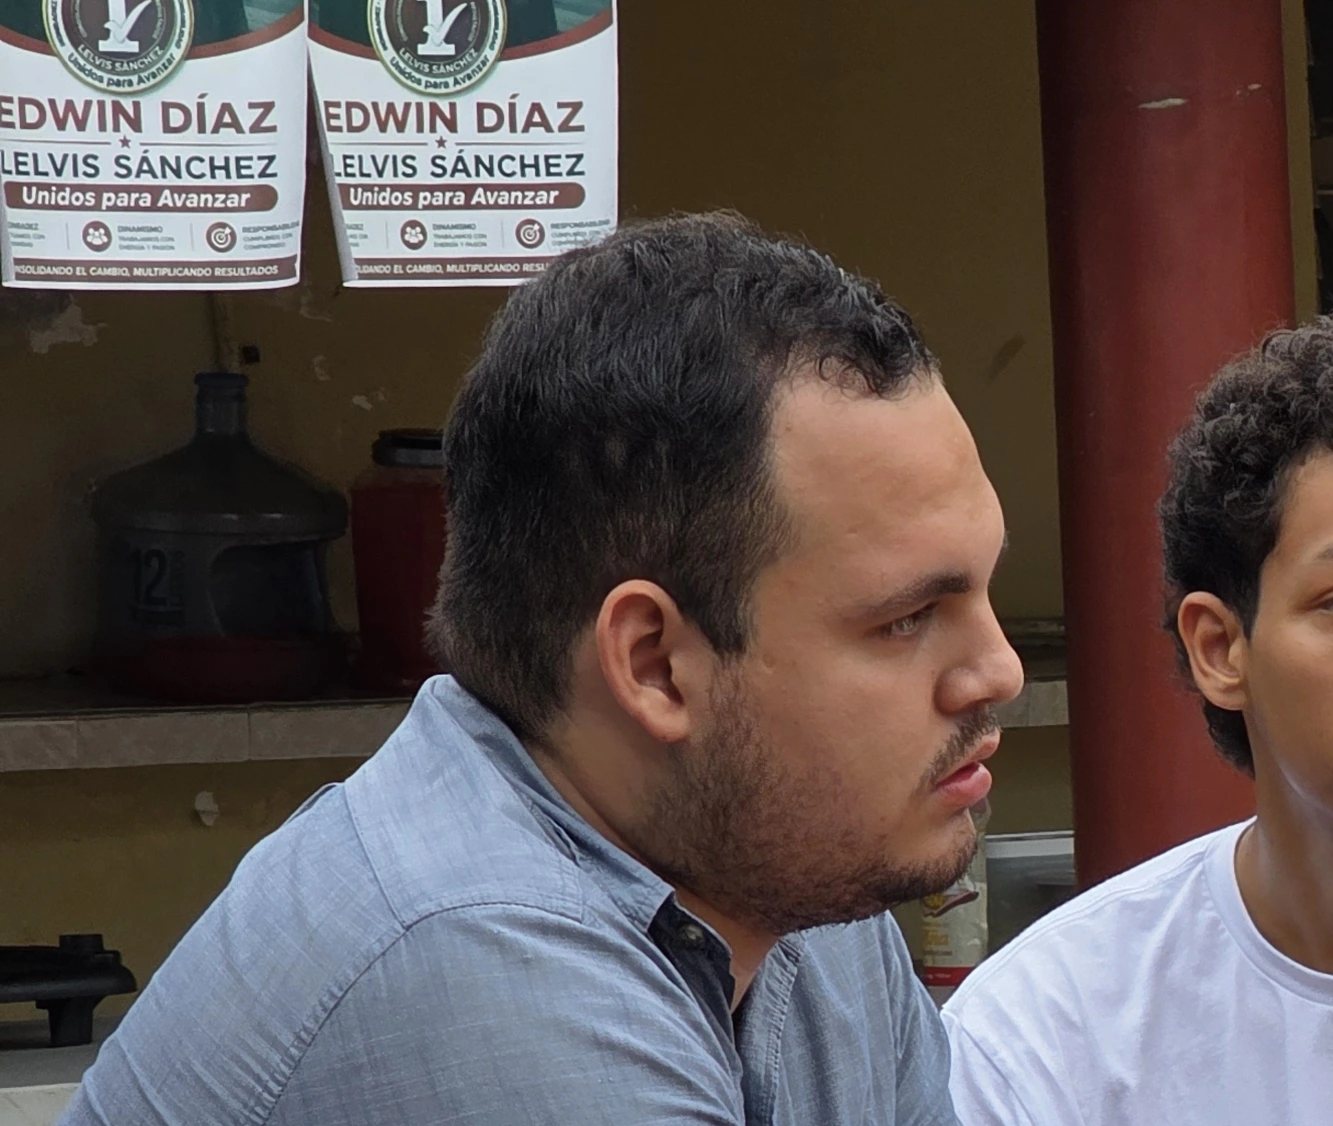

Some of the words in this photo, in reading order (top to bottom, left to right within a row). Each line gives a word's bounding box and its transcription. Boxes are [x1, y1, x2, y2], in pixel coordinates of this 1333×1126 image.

[68, 52, 105, 83] Unidos
[106, 78, 134, 88] para
[137, 53, 176, 86] Avanzar
[424, 80, 450, 90] para
[453, 55, 490, 87] Avanzar
[0, 96, 142, 133] EDWIN
[161, 93, 278, 134] DÍAZ
[323, 100, 458, 133] EDWIN
[476, 93, 586, 134] DÍAZ
[1, 150, 100, 178] LELVIS
[114, 149, 278, 180] SÁNCHEZ
[430, 149, 586, 179] SÁNCHEZ
[22, 186, 95, 207] Unidos
[101, 190, 151, 209] para
[157, 189, 251, 207] Avanzar
[349, 187, 412, 206] Unidos
[418, 190, 466, 209] para
[471, 188, 560, 206] Avanzar
[15, 265, 73, 275] NSOLIDANDO
[75, 266, 87, 276] EL
[90, 266, 130, 277] CAMBIO,
[132, 266, 212, 277] MULTIPLICANDO
[214, 265, 279, 276] RESULTADOS
[393, 264, 404, 274] EL
[406, 264, 443, 275] CAMBIO,
[446, 263, 520, 273] MULTIPLICANDO
